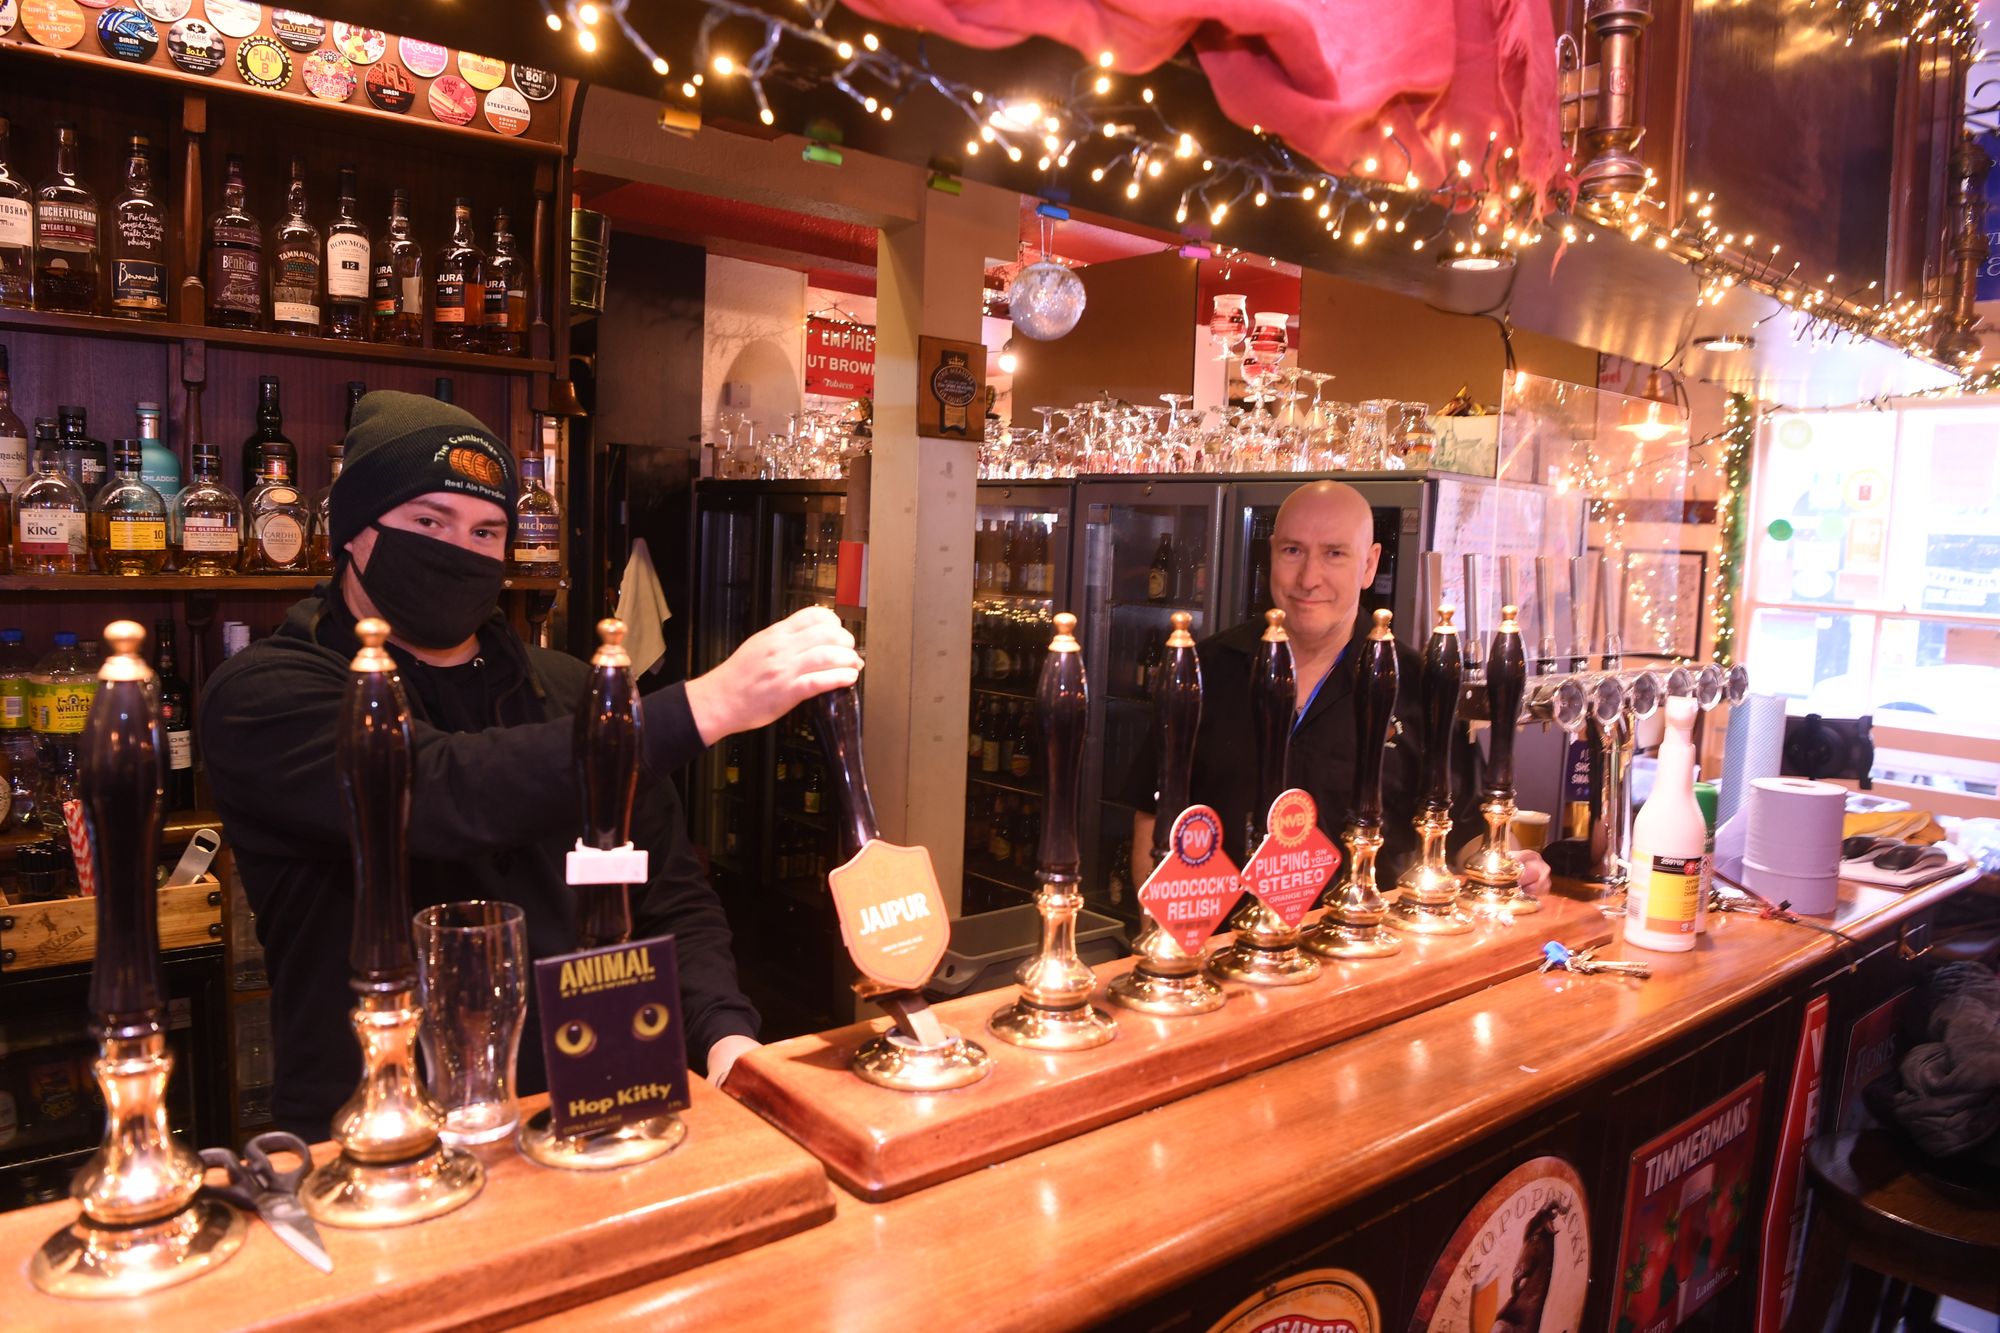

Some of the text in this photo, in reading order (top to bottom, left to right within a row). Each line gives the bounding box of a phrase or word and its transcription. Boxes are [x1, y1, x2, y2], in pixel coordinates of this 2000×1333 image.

[38, 24, 72, 33] MANGO
[280, 23, 321, 36] VELVETEEN
[118, 36, 139, 45] SIREN
[253, 49, 278, 64] PLAN
[261, 63, 269, 74] B
[382, 88, 400, 97] SIREN
[486, 102, 529, 115] STEEPLECHASE
[40, 206, 97, 222] AUCHENTOSHAN
[126, 212, 139, 221] The
[47, 224, 64, 232] YEARS
[330, 240, 369, 255] BOWMORE
[346, 261, 356, 270] 12
[376, 265, 393, 274] URA
[437, 273, 464, 283] JURA
[485, 280, 506, 289] URA
[445, 286, 453, 295] 10
[821, 329, 873, 353] EMPIRE
[434, 444, 449, 462] The
[444, 479, 464, 487] Real
[466, 481, 479, 492] Ale
[27, 526, 58, 535] KING
[153, 529, 164, 540] 10
[1281, 812, 1305, 829] NVB
[1182, 829, 1211, 849] PW
[1256, 849, 1328, 878] PULPING ON
[1311, 855, 1333, 865] YOUR
[1148, 875, 1239, 900] WOODCOCK'S
[1258, 869, 1325, 894] STEREO
[1269, 888, 1316, 904] ORANGE IPA
[858, 892, 931, 936] JAIPUR
[1167, 898, 1220, 921] RELISH
[1285, 904, 1301, 913] ABV
[560, 946, 656, 992] ANIMAL
[568, 1082, 672, 1118] Hop Kitty
[1644, 1097, 1752, 1197] TIMMERMANS
[1695, 1266, 1729, 1300] Lambic
